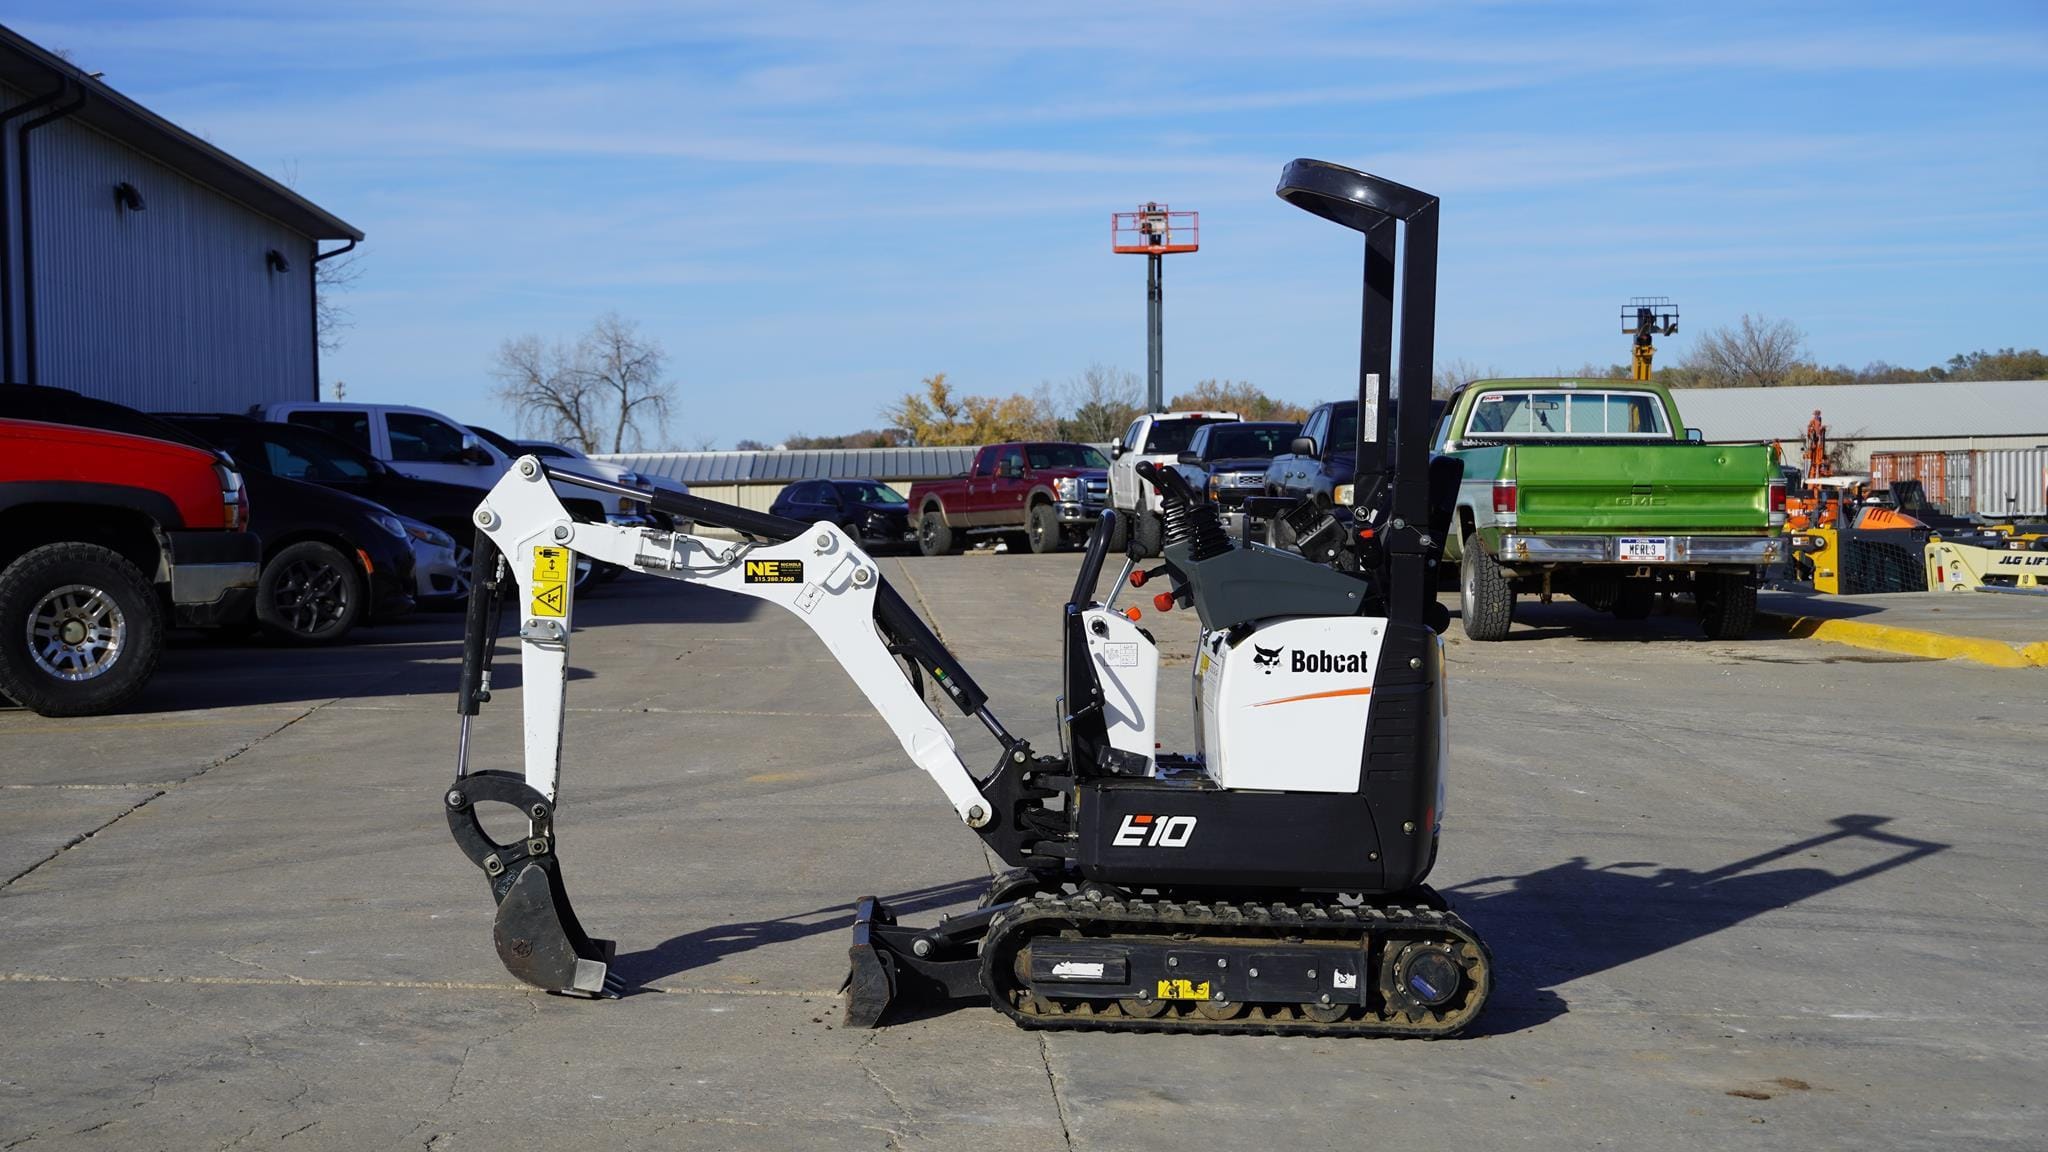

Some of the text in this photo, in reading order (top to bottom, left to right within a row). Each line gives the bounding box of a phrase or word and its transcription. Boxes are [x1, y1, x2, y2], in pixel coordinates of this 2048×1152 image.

[1615, 496, 1666, 507] GMC
[1999, 556, 2023, 565] JLG
[747, 561, 779, 576] NE
[1291, 649, 1368, 673] Bobcat
[1112, 814, 1198, 848] E10
